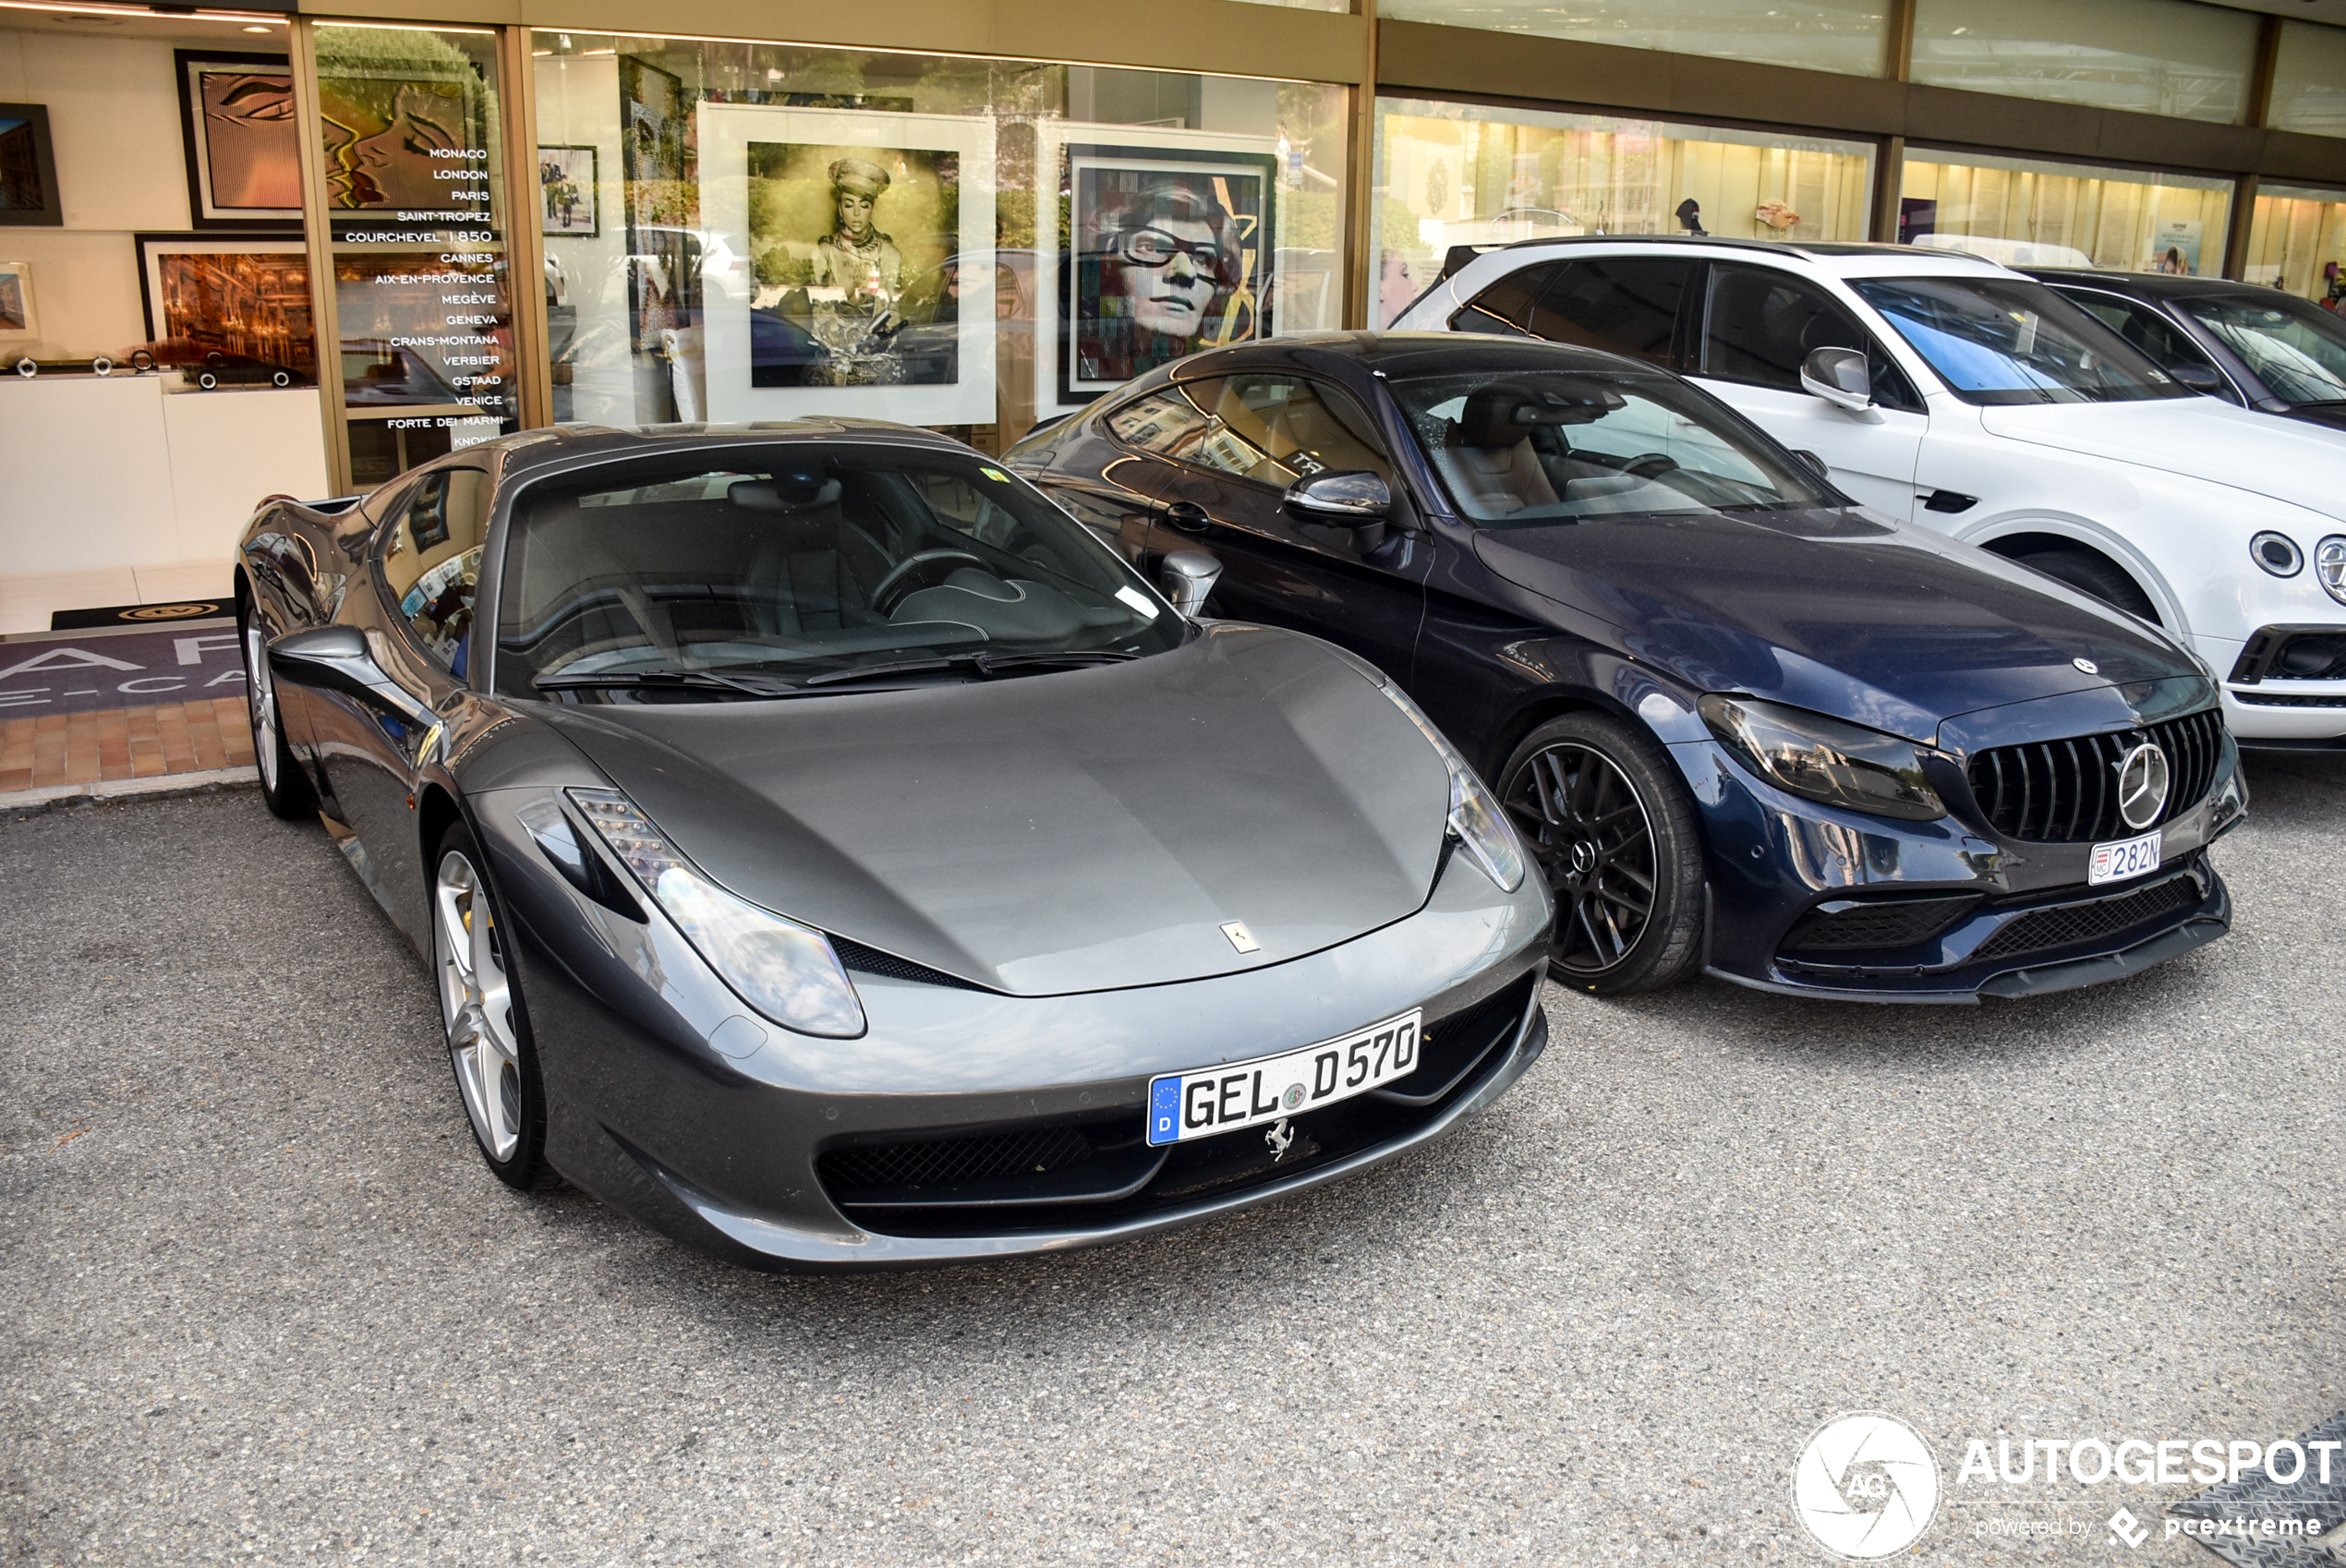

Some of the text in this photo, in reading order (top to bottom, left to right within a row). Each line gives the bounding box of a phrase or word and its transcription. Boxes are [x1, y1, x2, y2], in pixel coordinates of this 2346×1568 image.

[429, 149, 488, 160] MONACO
[433, 169, 489, 180] LONDON
[451, 190, 490, 201] PARIS
[397, 211, 491, 222] SAINT-TROPEZ
[345, 231, 492, 243] COURCHEVEL 1850
[440, 253, 494, 263] CANNES
[375, 273, 495, 284] AIX-EN-PROVENCE
[441, 291, 497, 305] MEGÈVE
[445, 315, 498, 325] GENEVA
[390, 335, 500, 347] CRANS-MONTANA
[442, 356, 500, 367] VERBIER
[452, 376, 502, 386] GSTAAD
[455, 395, 503, 406] VENICE
[387, 416, 503, 429] FORTE DEI MARMI
[453, 436, 500, 447] KNOK
[2112, 837, 2159, 876] 282N
[2097, 864, 2108, 873] MC
[1185, 1069, 1279, 1129] GEL
[1159, 1116, 1171, 1132] D
